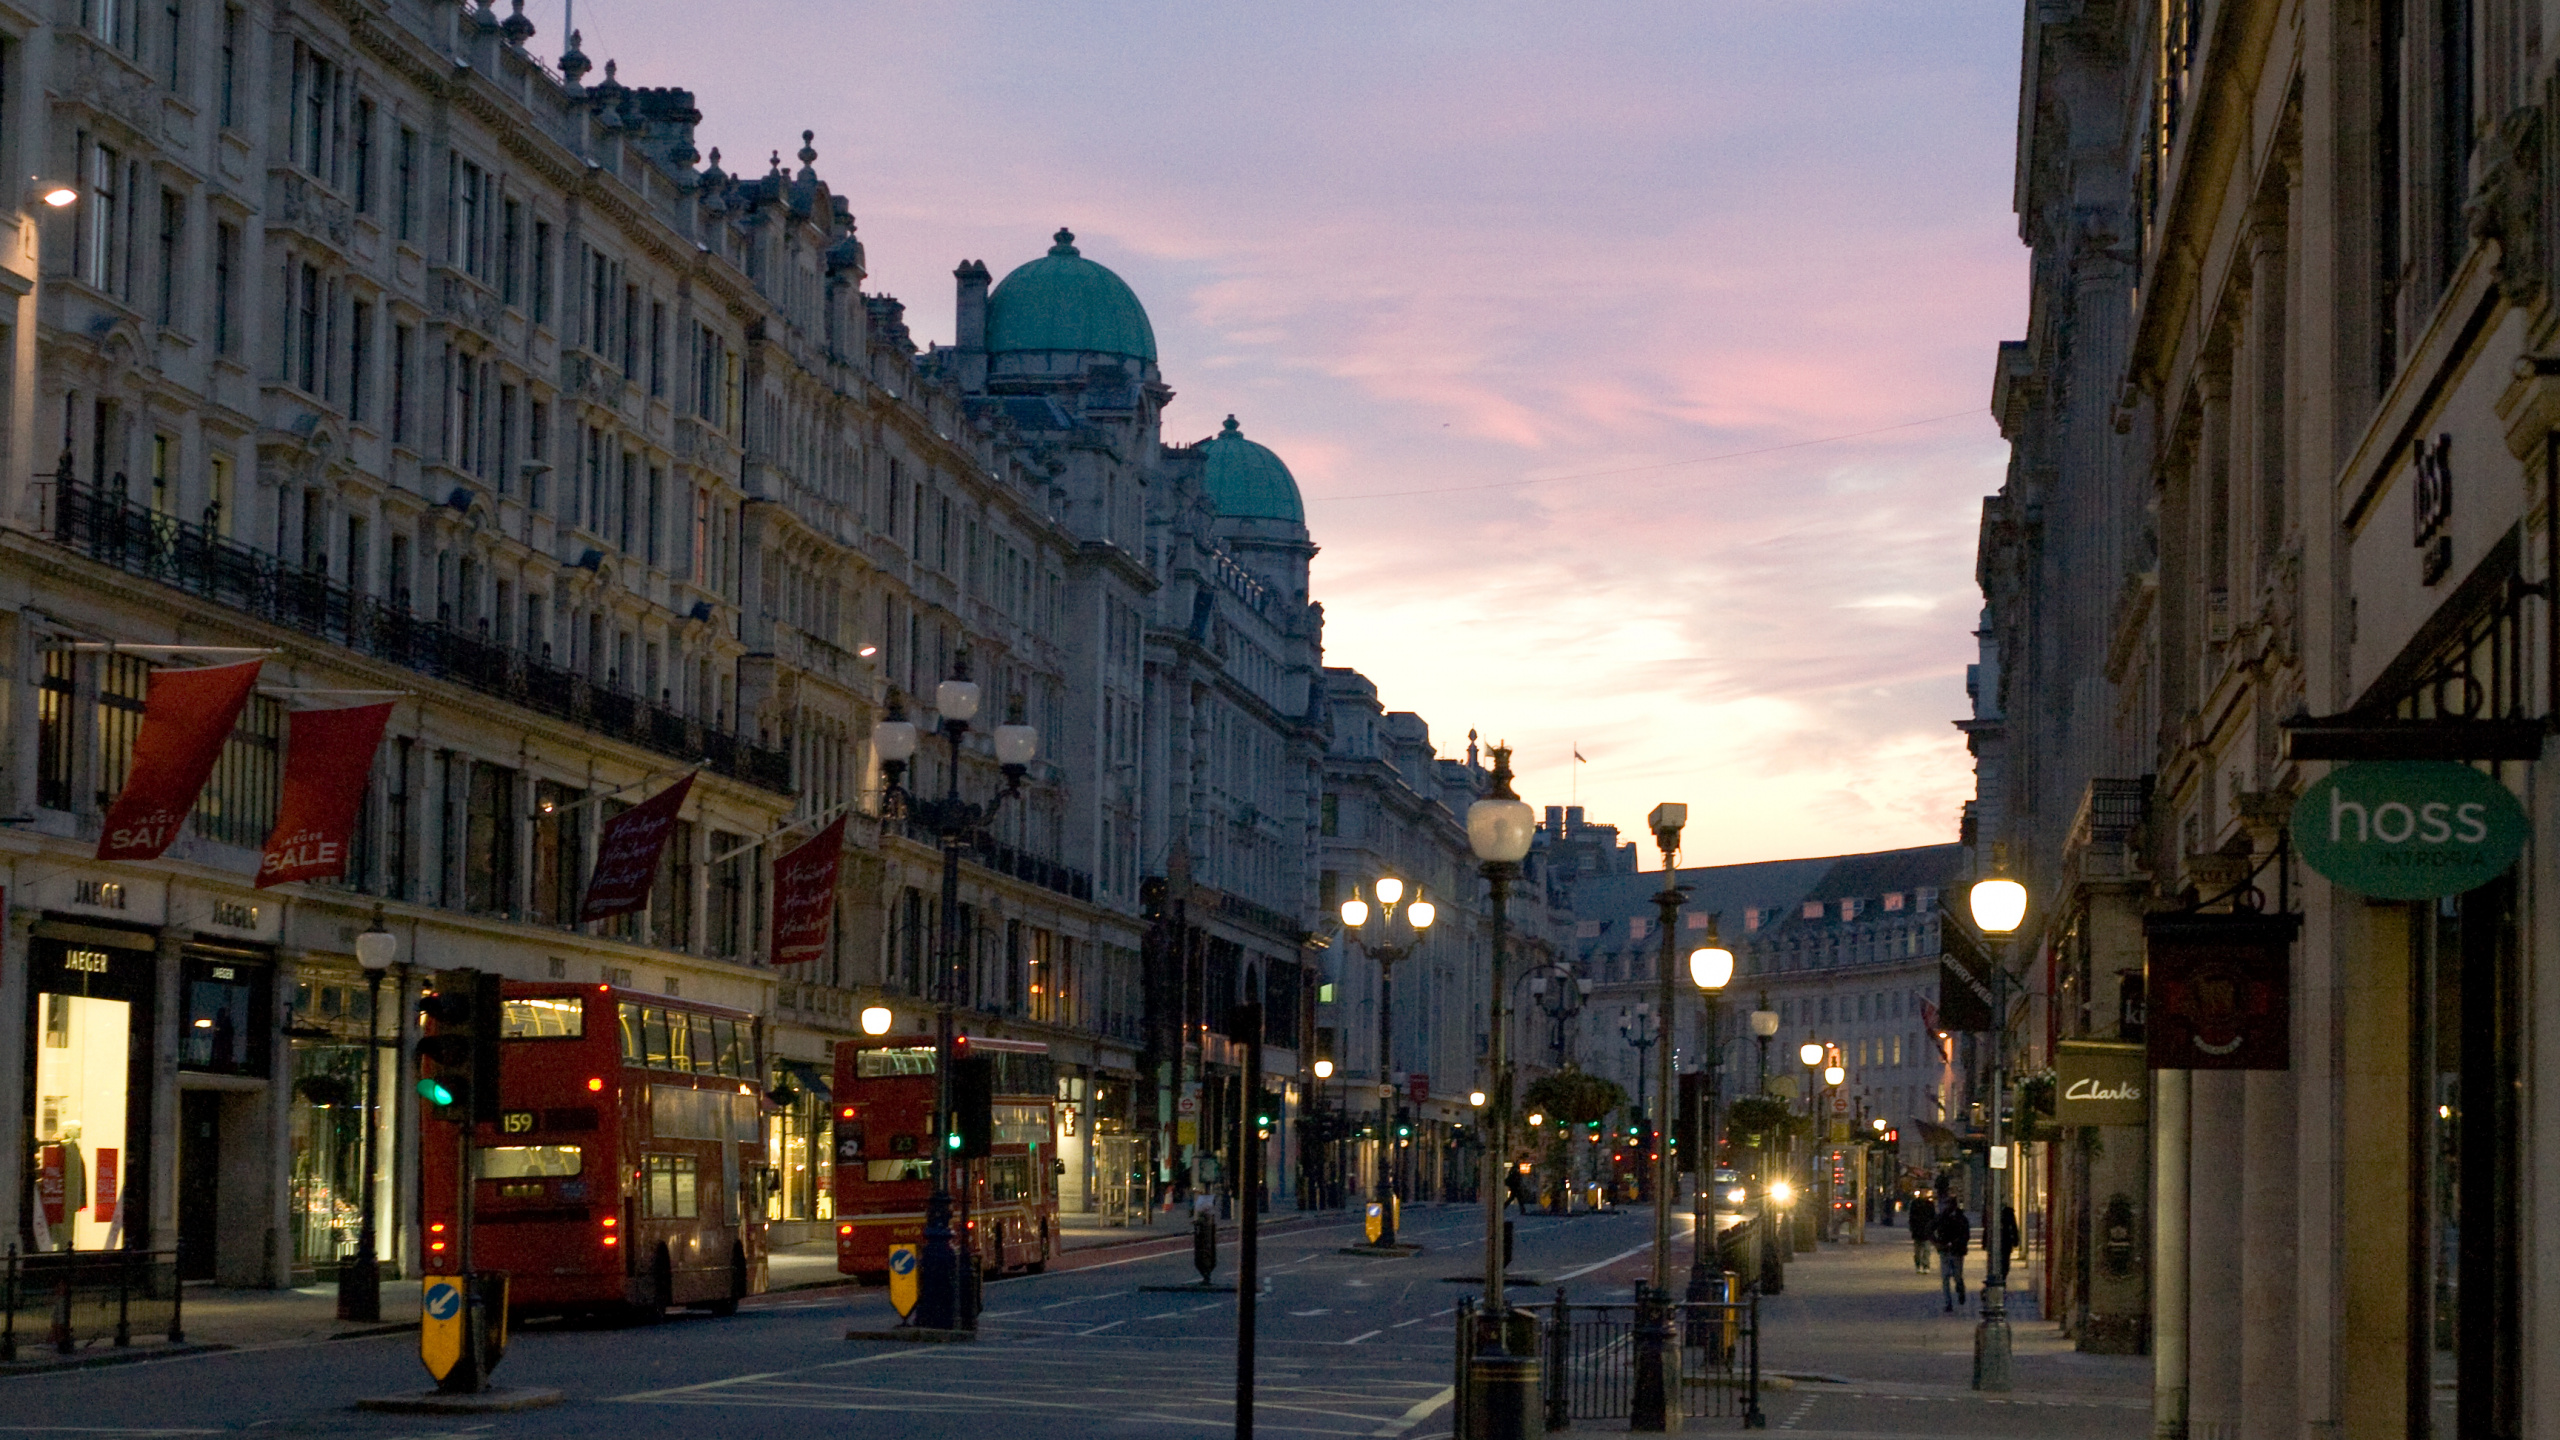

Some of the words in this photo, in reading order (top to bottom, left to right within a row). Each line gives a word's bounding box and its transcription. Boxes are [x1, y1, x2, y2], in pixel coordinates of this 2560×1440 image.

[2330, 786, 2488, 843] hoss
[262, 841, 339, 875] SALE
[74, 879, 126, 910] JAEGER
[211, 897, 258, 930] JAEGER
[64, 949, 109, 974] JAEGER
[212, 966, 236, 981] JAEGER
[1942, 953, 1975, 984] GERRY
[2065, 1078, 2141, 1101] Clarks
[504, 1112, 534, 1134] 159
